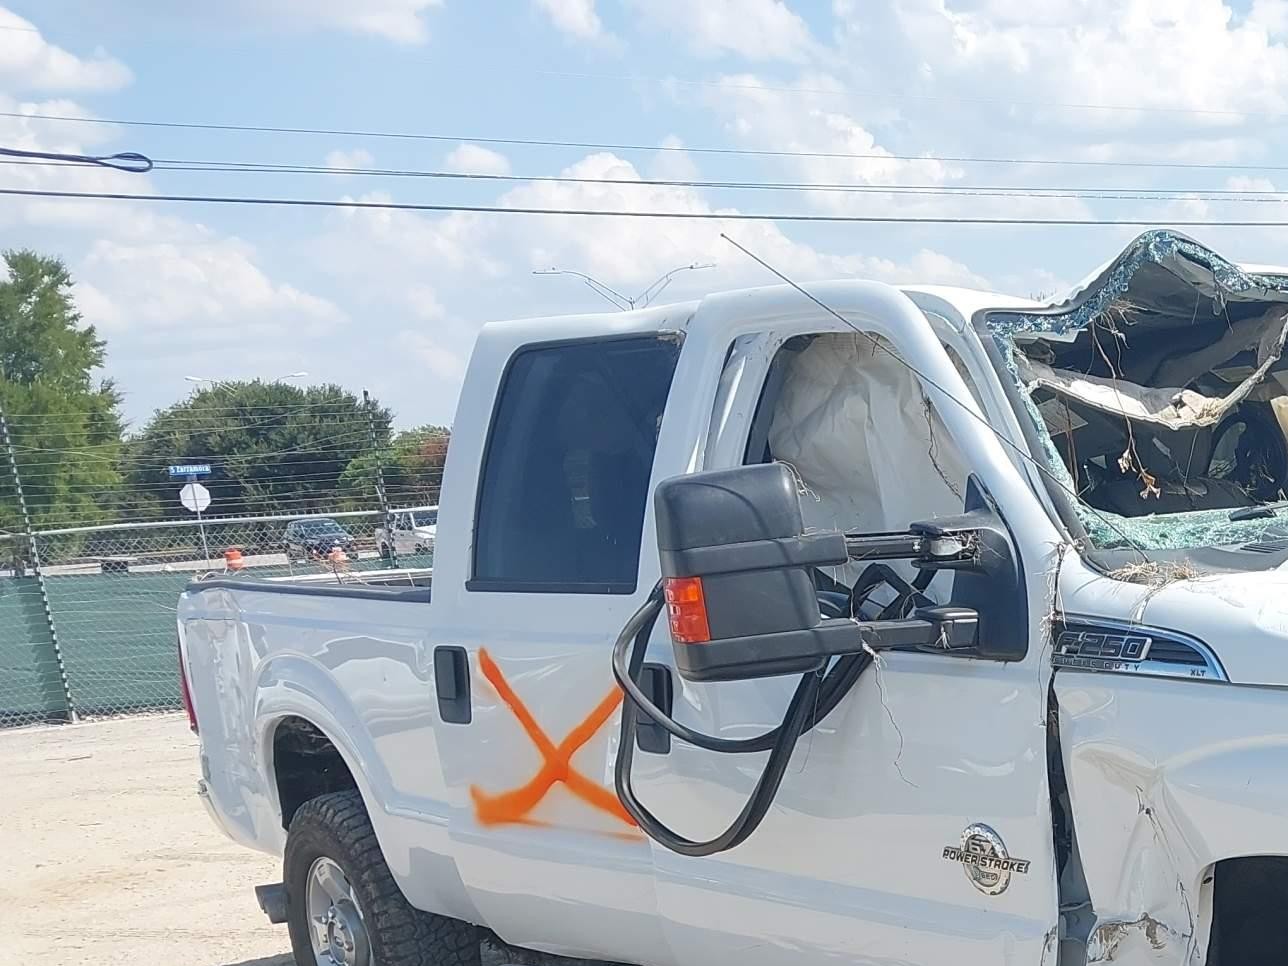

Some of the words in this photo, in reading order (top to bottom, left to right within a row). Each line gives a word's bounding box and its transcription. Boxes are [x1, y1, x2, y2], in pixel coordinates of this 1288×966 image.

[1190, 668, 1207, 678] XLT
[942, 848, 979, 865] POWER
[979, 855, 1026, 874] STROKE
